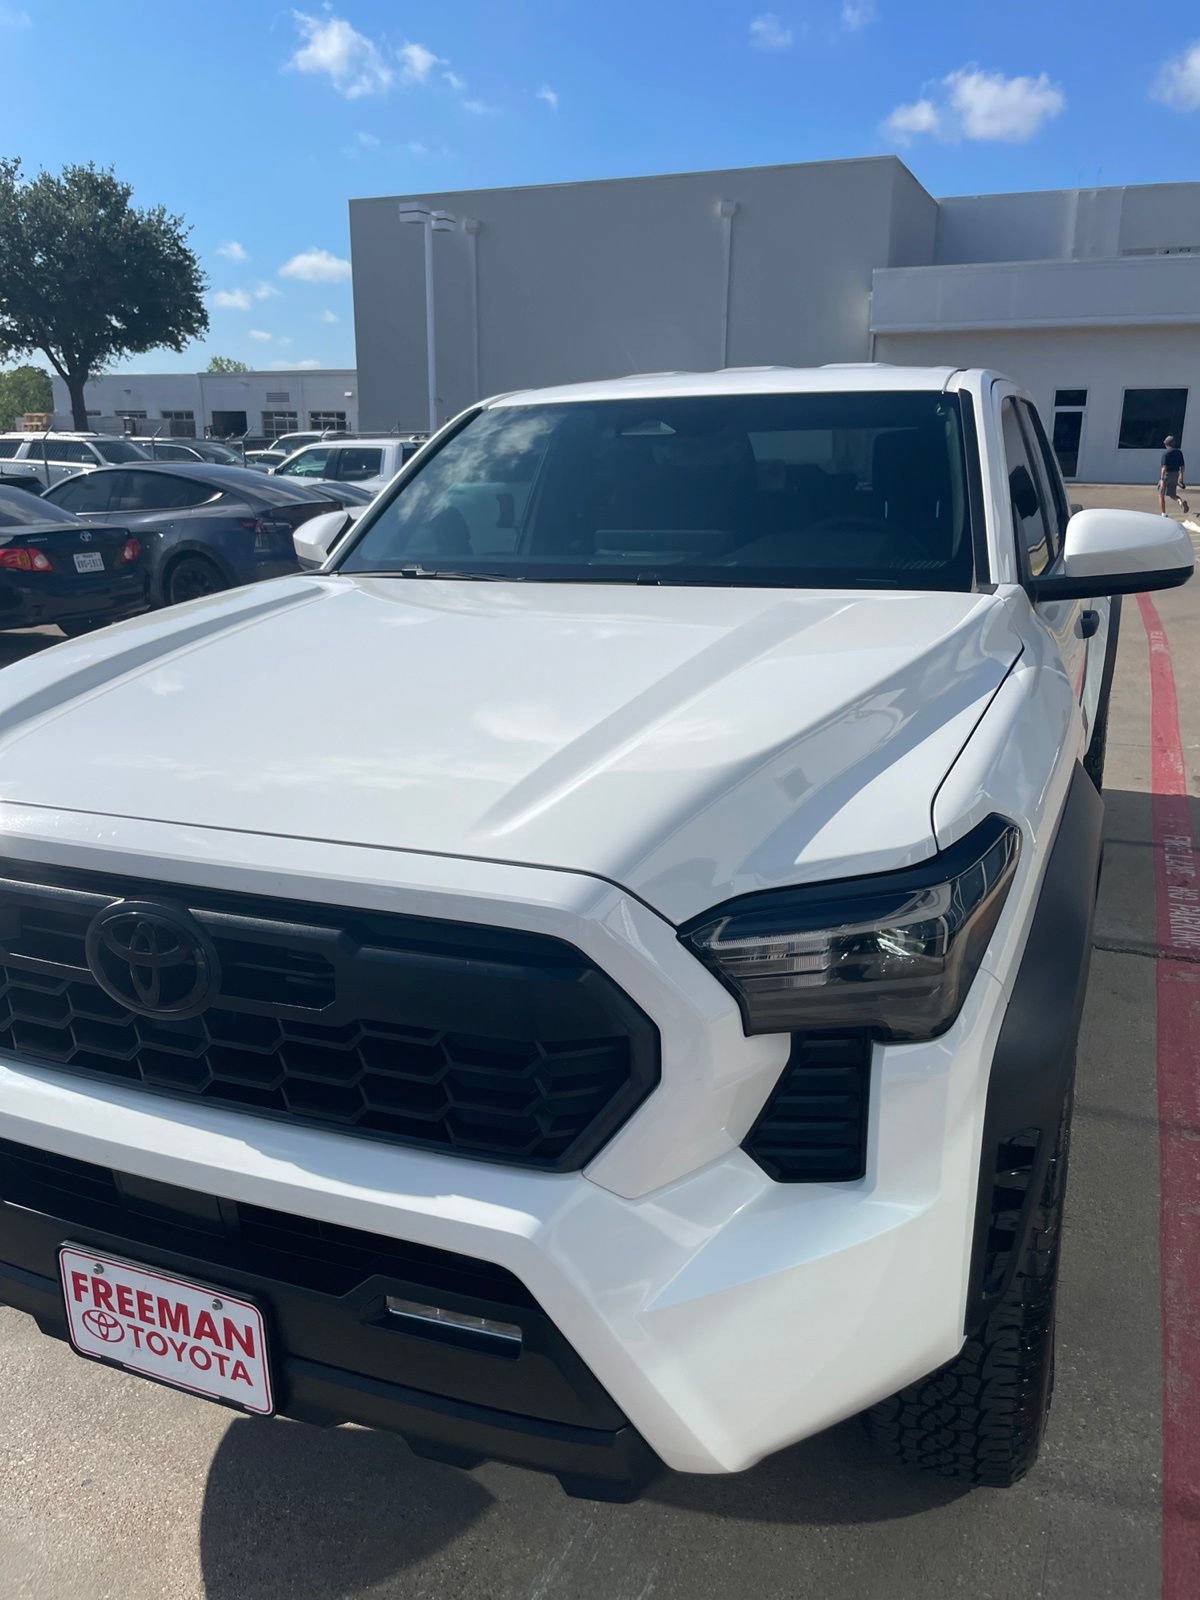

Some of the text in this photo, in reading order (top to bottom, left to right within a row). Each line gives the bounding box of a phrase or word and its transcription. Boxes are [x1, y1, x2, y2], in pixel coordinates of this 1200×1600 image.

[1163, 834, 1200, 949] FIRE LANE NO PARKING
[71, 1270, 256, 1359] FREEMAN
[126, 1323, 254, 1387] TOYOTA
